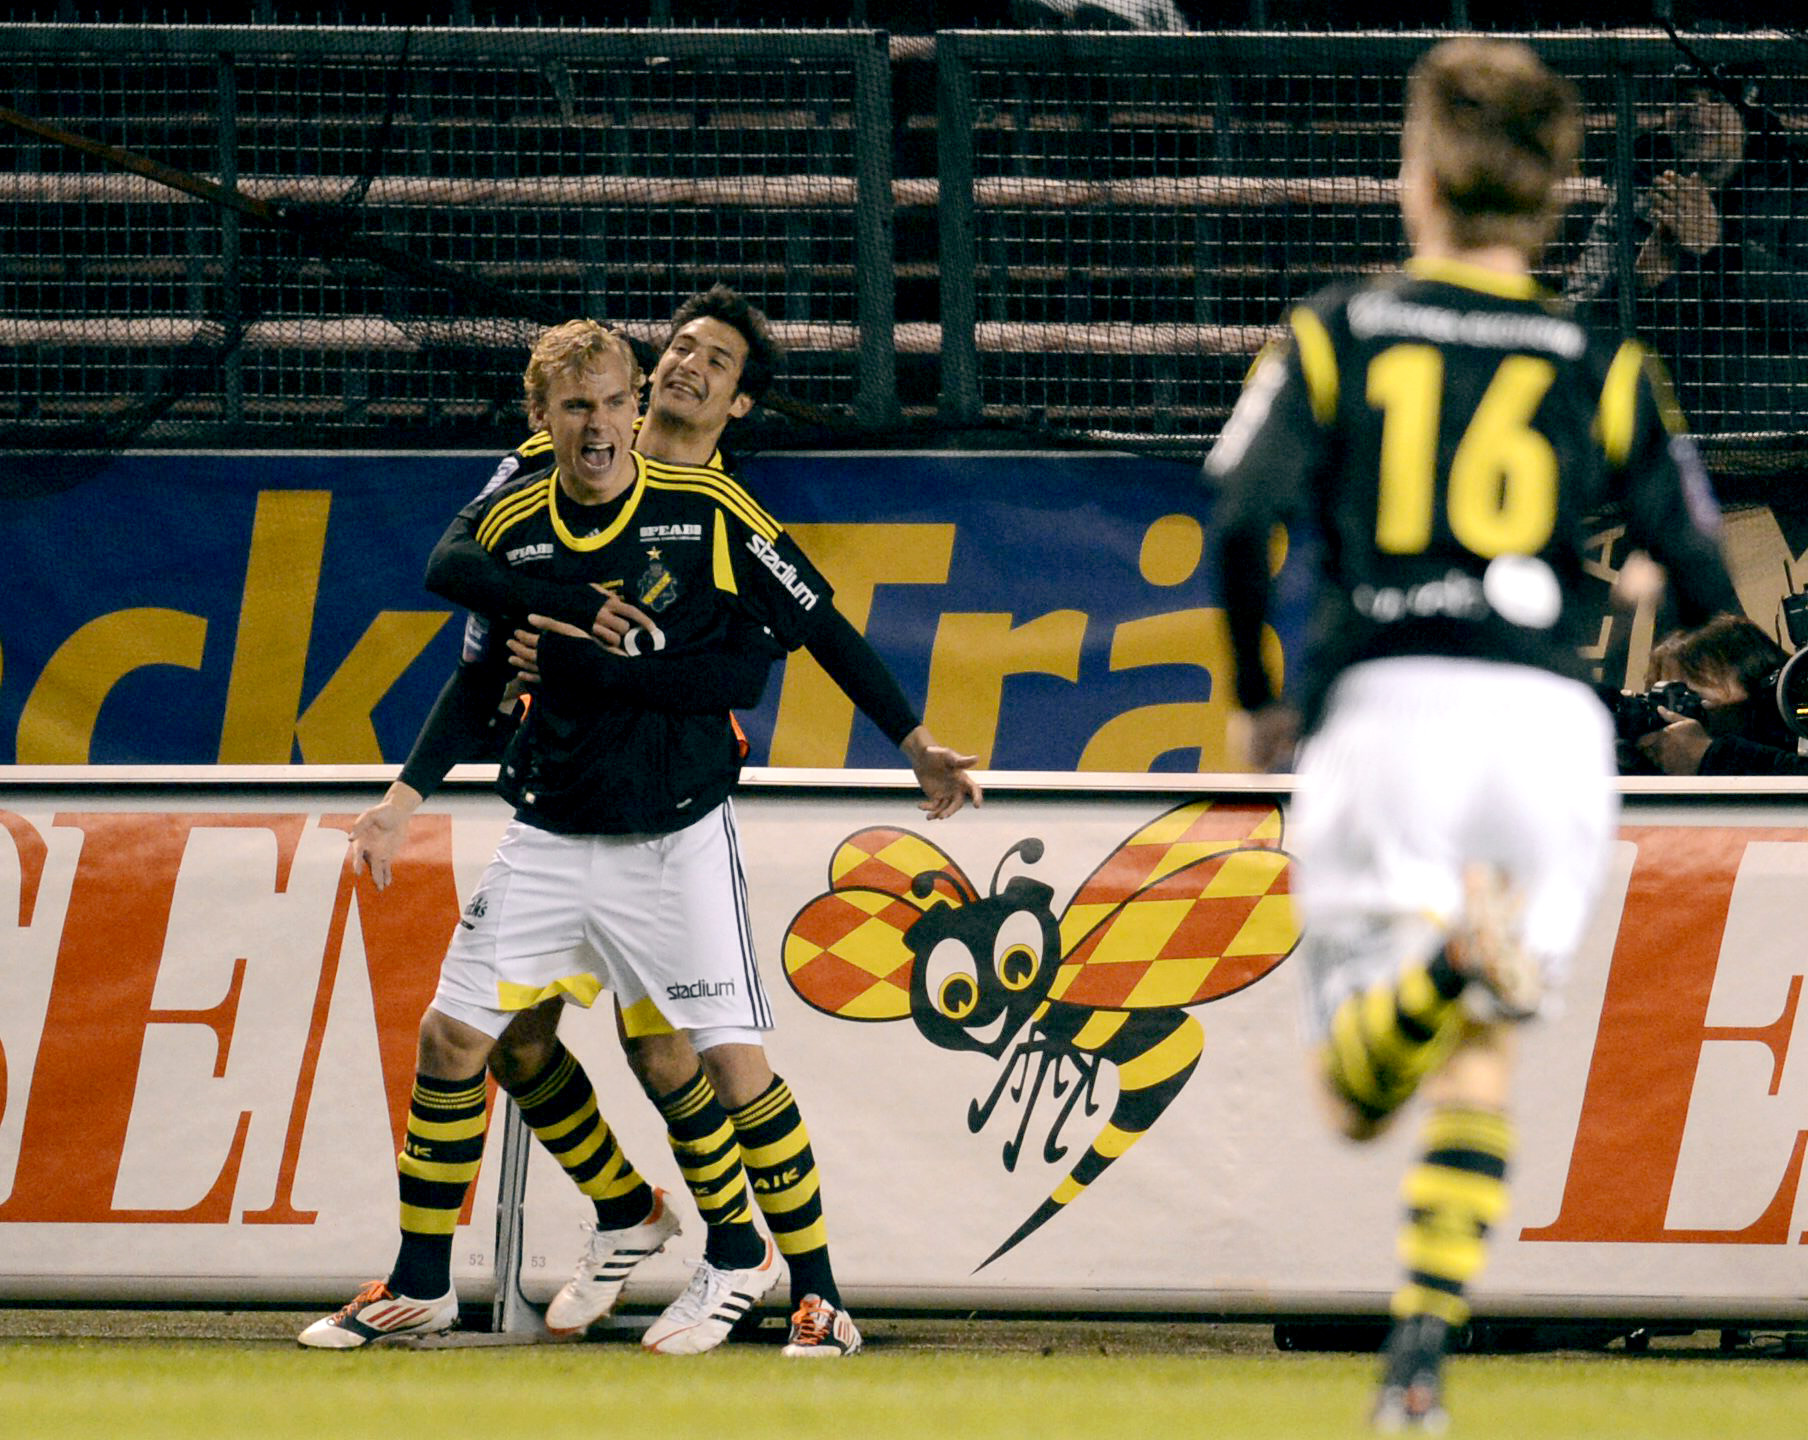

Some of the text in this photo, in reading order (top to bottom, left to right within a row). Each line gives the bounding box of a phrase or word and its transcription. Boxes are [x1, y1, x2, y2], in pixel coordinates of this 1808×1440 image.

[1366, 343, 1559, 558] 16
[745, 534, 819, 611] stadium
[0, 489, 452, 764] ck
[666, 979, 735, 1000] stadium
[754, 1167, 799, 1190] AIK
[469, 1254, 484, 1266] 52
[531, 1256, 546, 1268] 53
